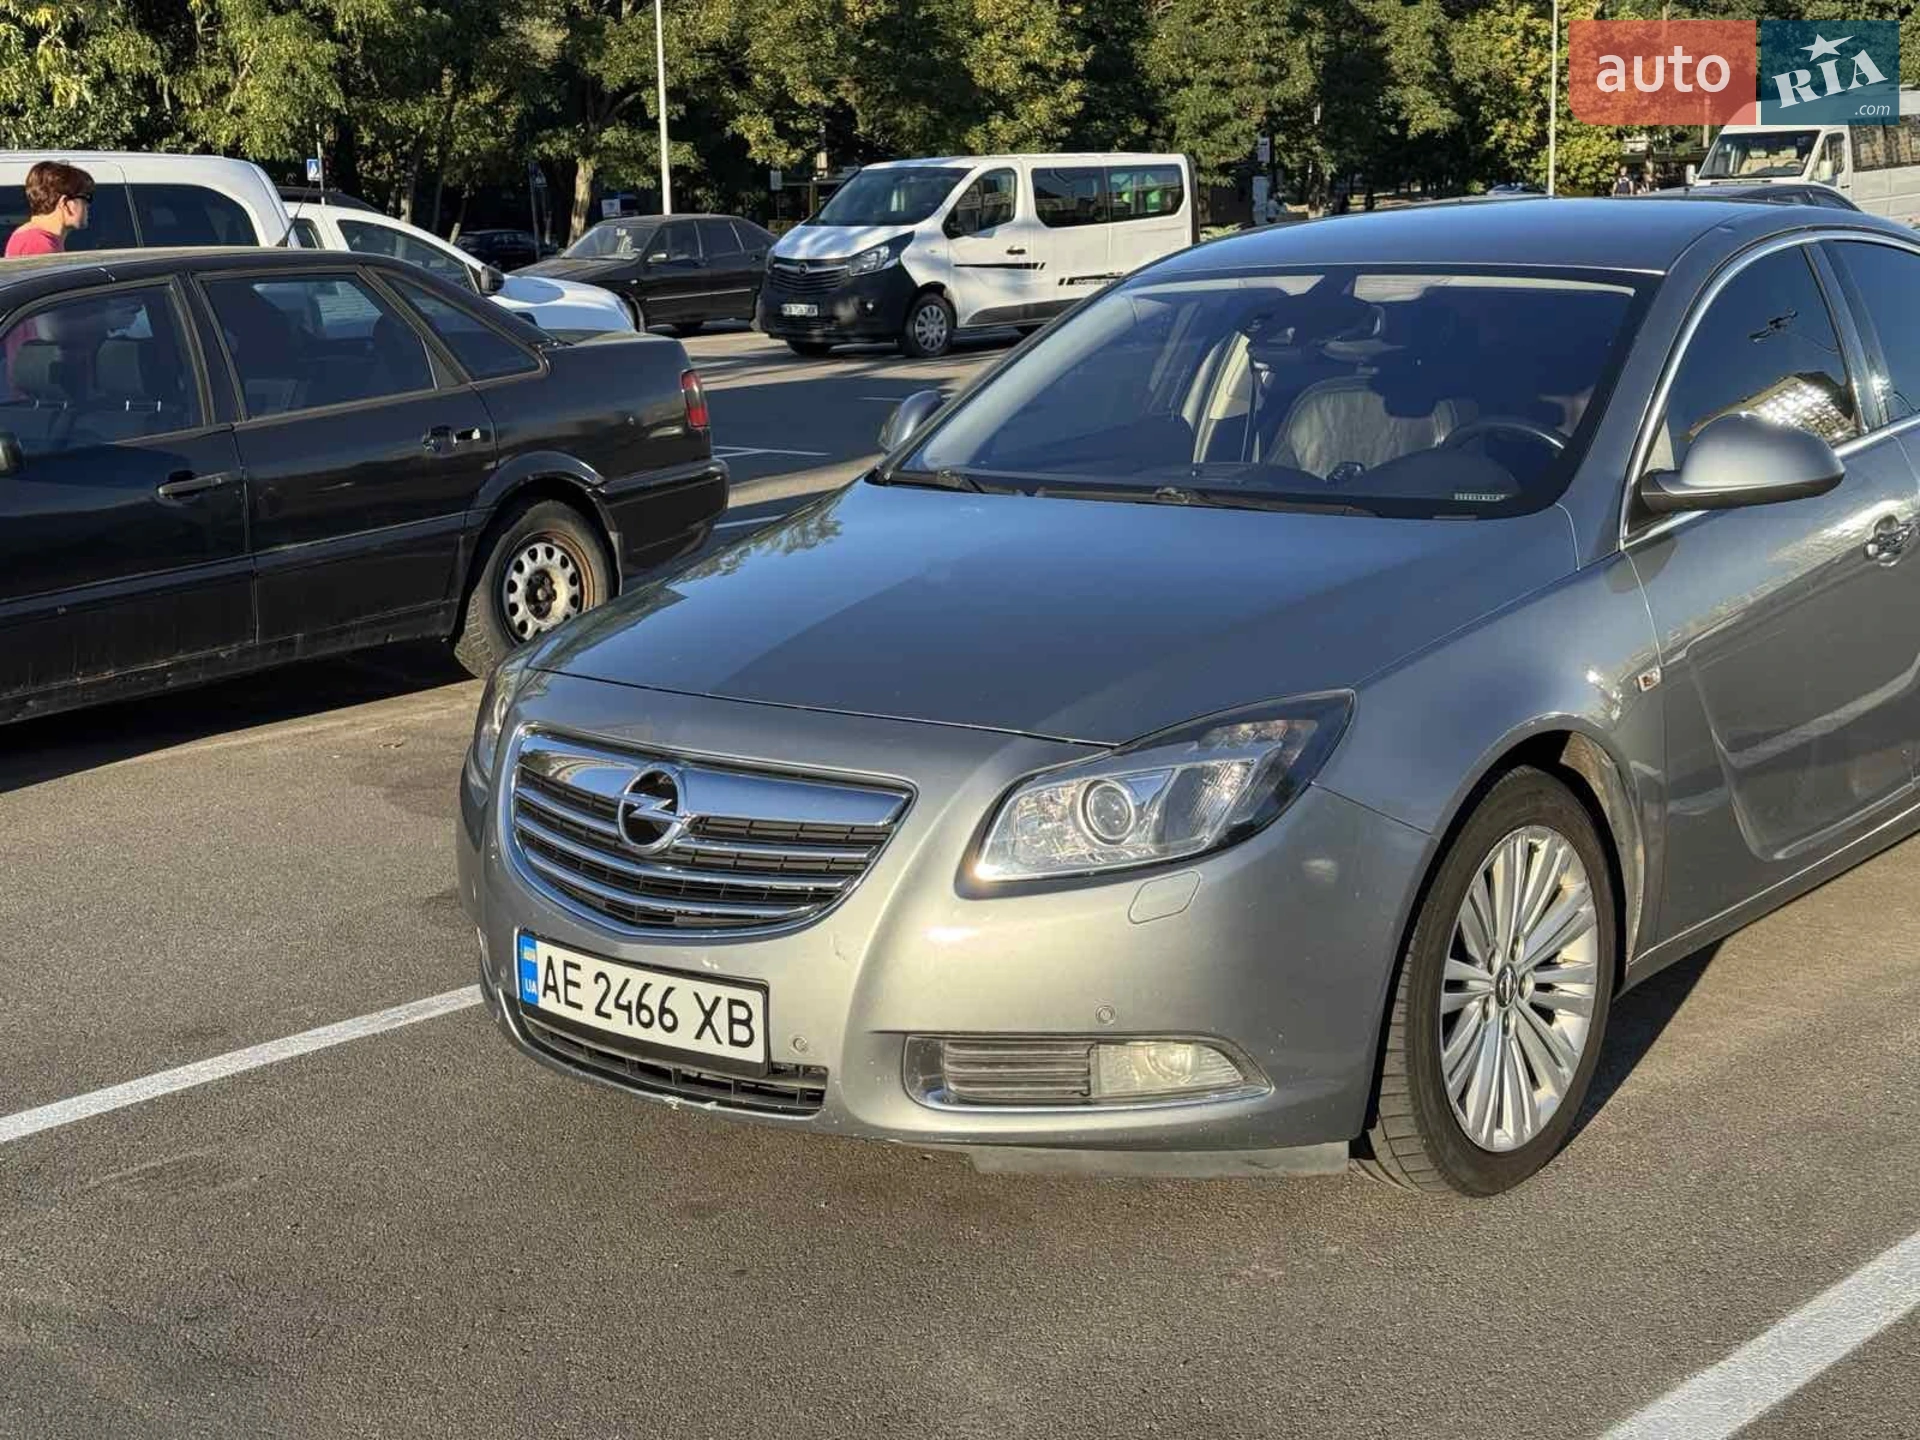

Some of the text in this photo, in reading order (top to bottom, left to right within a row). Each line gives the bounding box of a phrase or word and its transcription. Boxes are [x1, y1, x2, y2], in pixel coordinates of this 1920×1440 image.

[523, 977, 538, 996] UA
[542, 955, 755, 1049] AE 2466 XB
